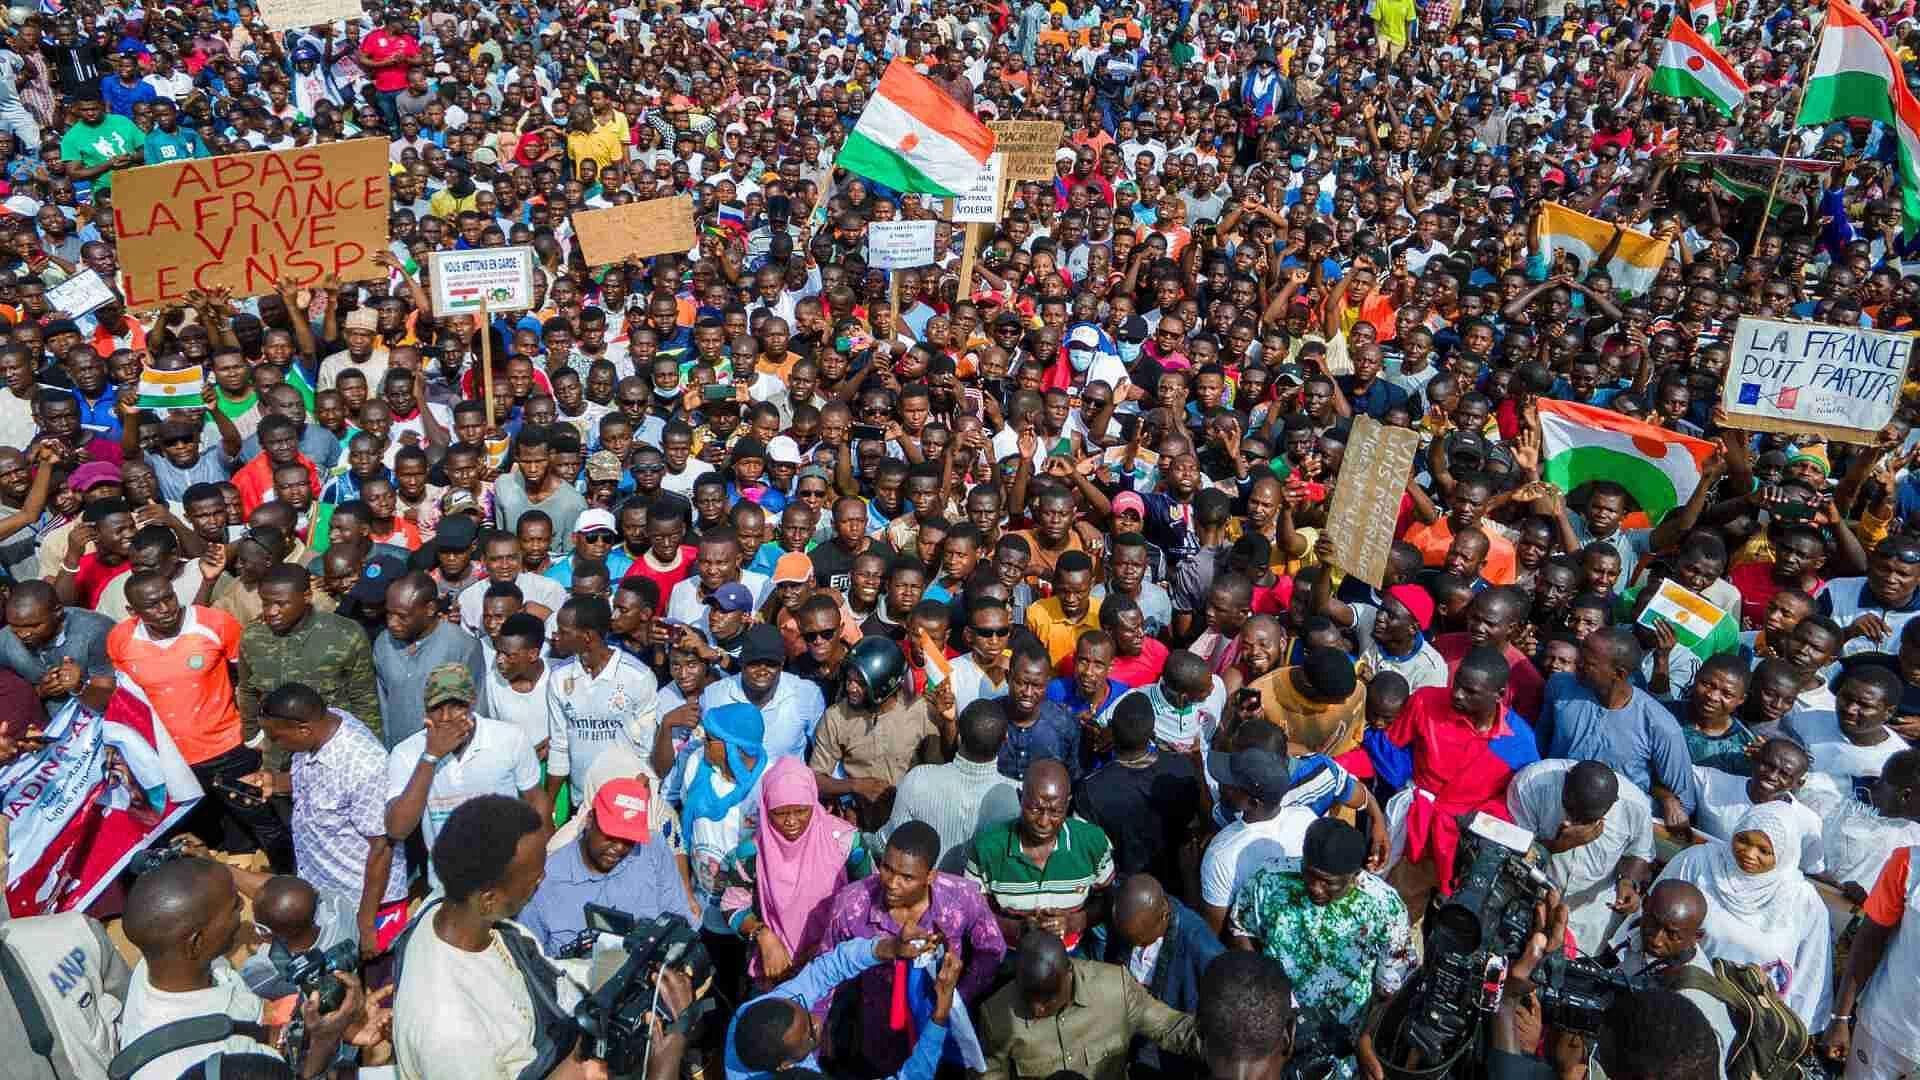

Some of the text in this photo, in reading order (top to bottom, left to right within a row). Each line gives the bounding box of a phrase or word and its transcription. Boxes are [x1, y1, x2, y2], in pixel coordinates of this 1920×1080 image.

[115, 176, 384, 239] LA FRANCE
[958, 205, 992, 214] VOLEUR
[194, 212, 337, 260] VIVE
[124, 266, 182, 306] LE
[194, 242, 365, 293] CNSP
[463, 260, 488, 271] METTONS
[1751, 328, 1910, 370] LA FRANCE
[1809, 363, 1898, 405] PARTIR
[48, 946, 86, 997] ANP
